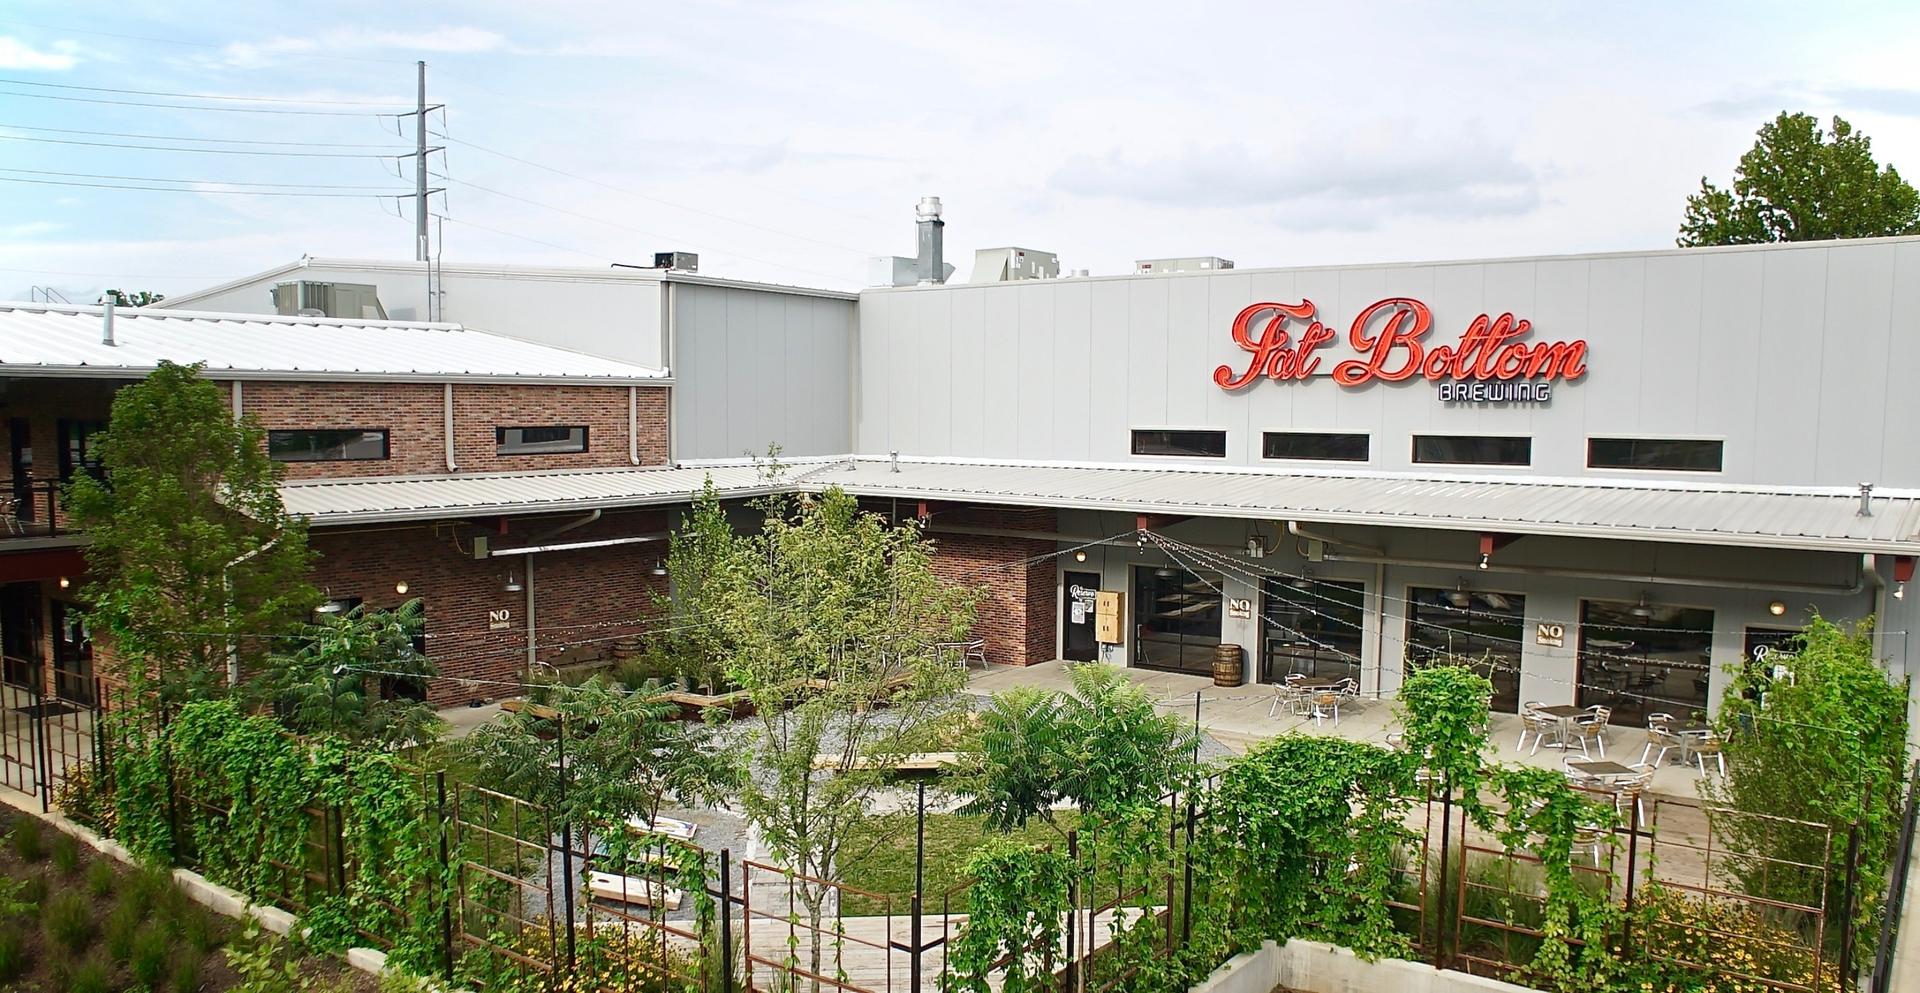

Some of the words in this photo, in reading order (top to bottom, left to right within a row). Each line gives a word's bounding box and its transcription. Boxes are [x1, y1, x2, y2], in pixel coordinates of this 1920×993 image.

[1213, 298, 1336, 391] Fat
[1331, 297, 1588, 388] Bottom
[1438, 383, 1551, 402] BREWING
[1230, 598, 1250, 611] NO
[490, 609, 510, 622] NO
[1538, 624, 1563, 638] NO
